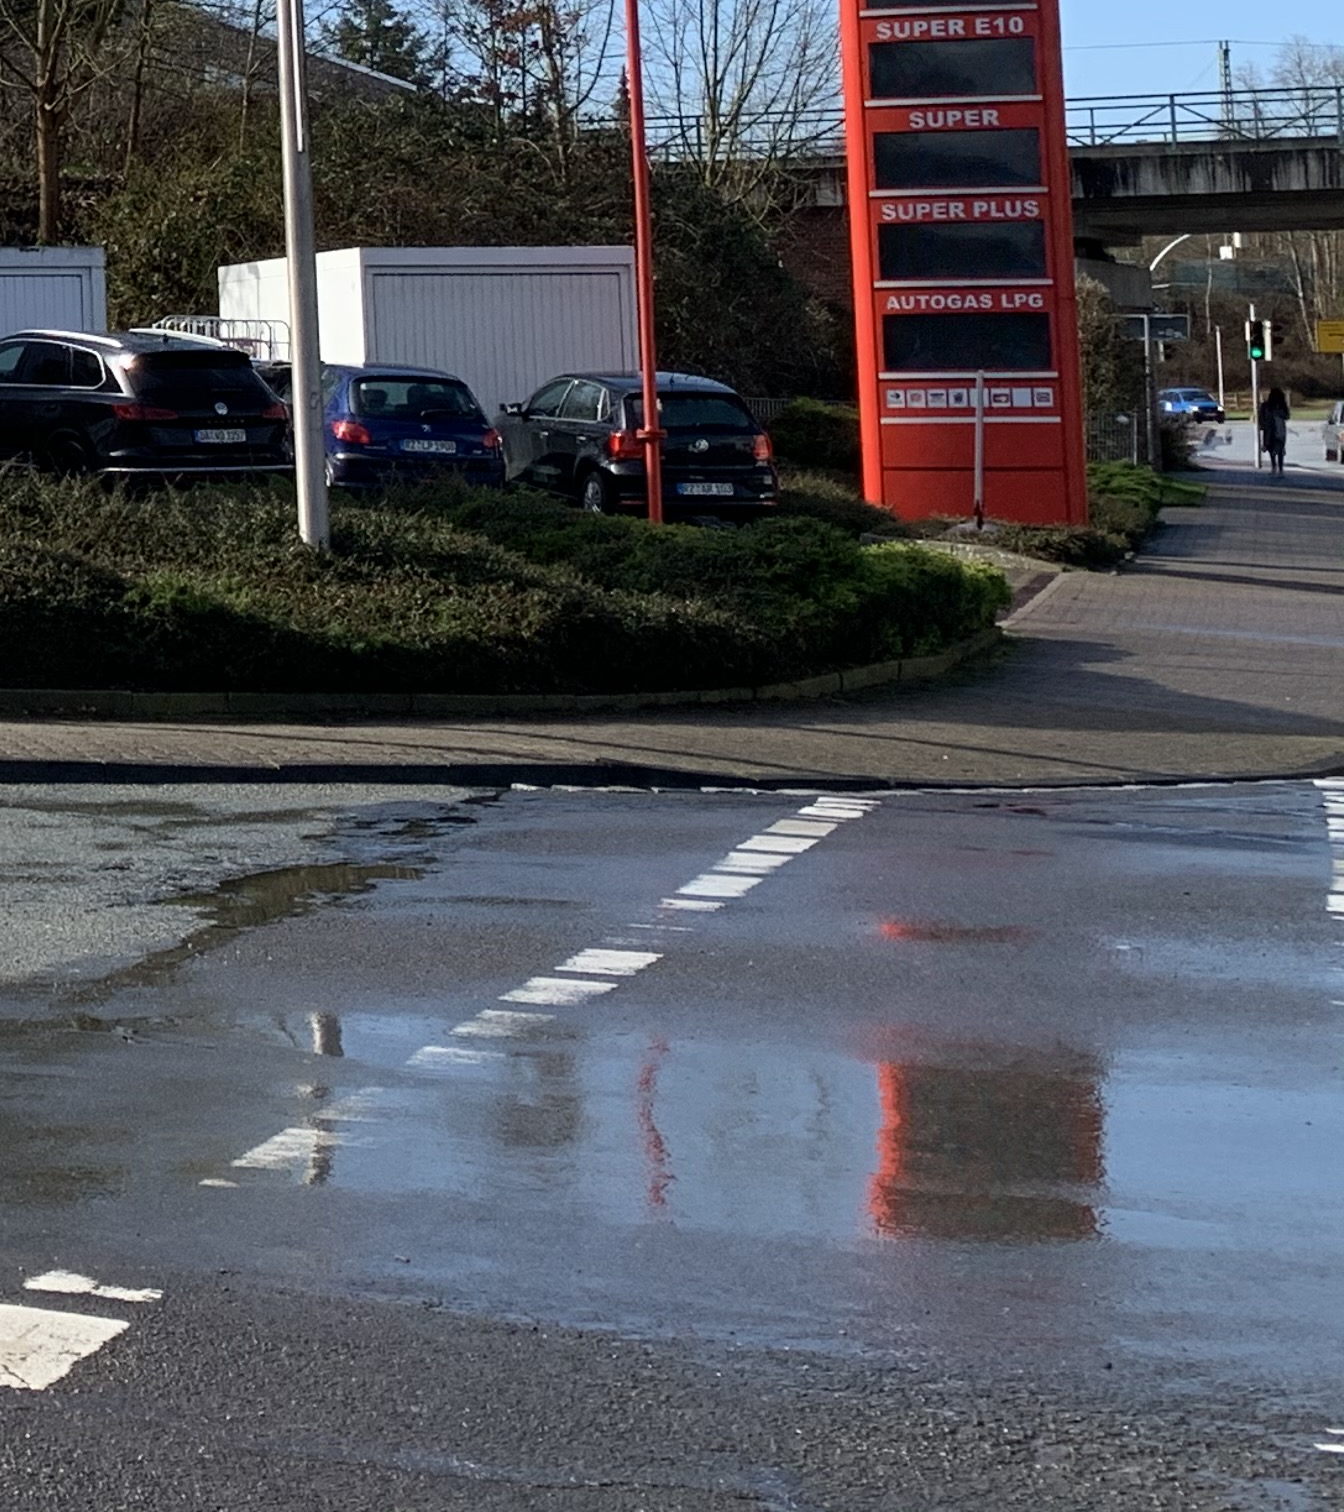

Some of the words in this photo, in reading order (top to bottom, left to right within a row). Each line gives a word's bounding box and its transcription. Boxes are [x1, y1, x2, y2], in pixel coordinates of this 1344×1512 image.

[877, 19, 965, 39] SUPER
[975, 16, 1024, 35] E10
[909, 109, 999, 128] SUPER
[881, 202, 966, 220] SUPER
[973, 200, 1040, 218] PLUS
[886, 294, 992, 310] AUTOGAS
[1001, 293, 1043, 308] LPG
